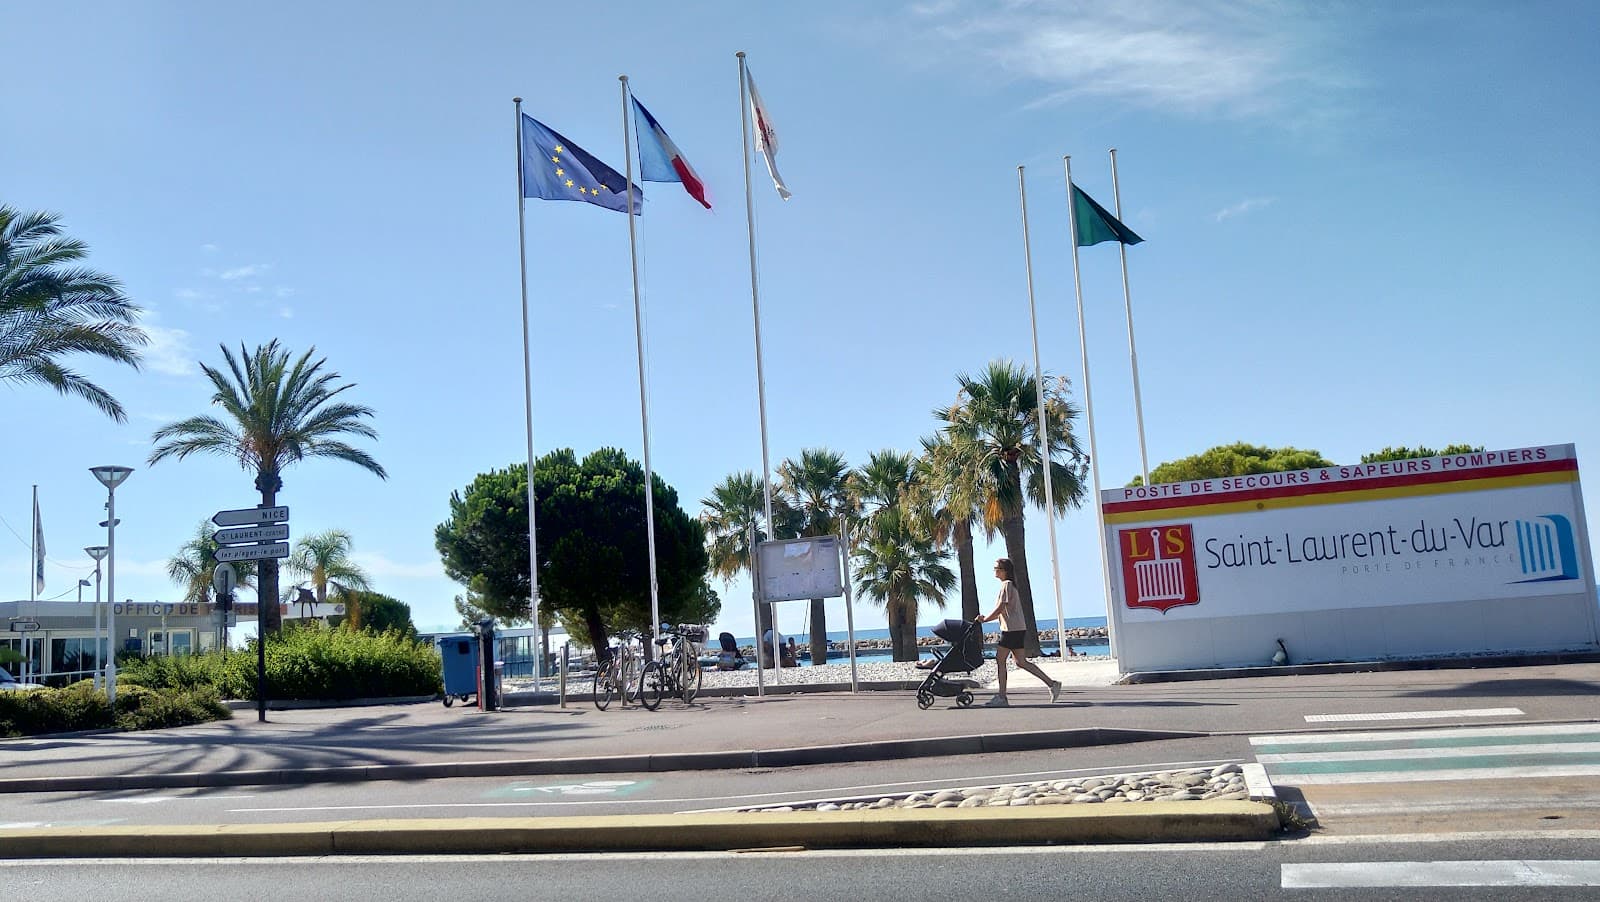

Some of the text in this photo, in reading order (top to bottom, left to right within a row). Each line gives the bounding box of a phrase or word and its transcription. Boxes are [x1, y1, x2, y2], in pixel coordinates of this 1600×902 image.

[1124, 448, 1547, 500] POSTE DE SECOURS & SAPEURS POMPIERS
[262, 510, 285, 519] NICE
[230, 530, 262, 540] LAURENT
[1205, 517, 1509, 568] Saint-Laurent-du-Var
[1342, 553, 1515, 575] PORTE DE FRANCE
[114, 603, 173, 615] OFFIC
[180, 603, 198, 615] DE
